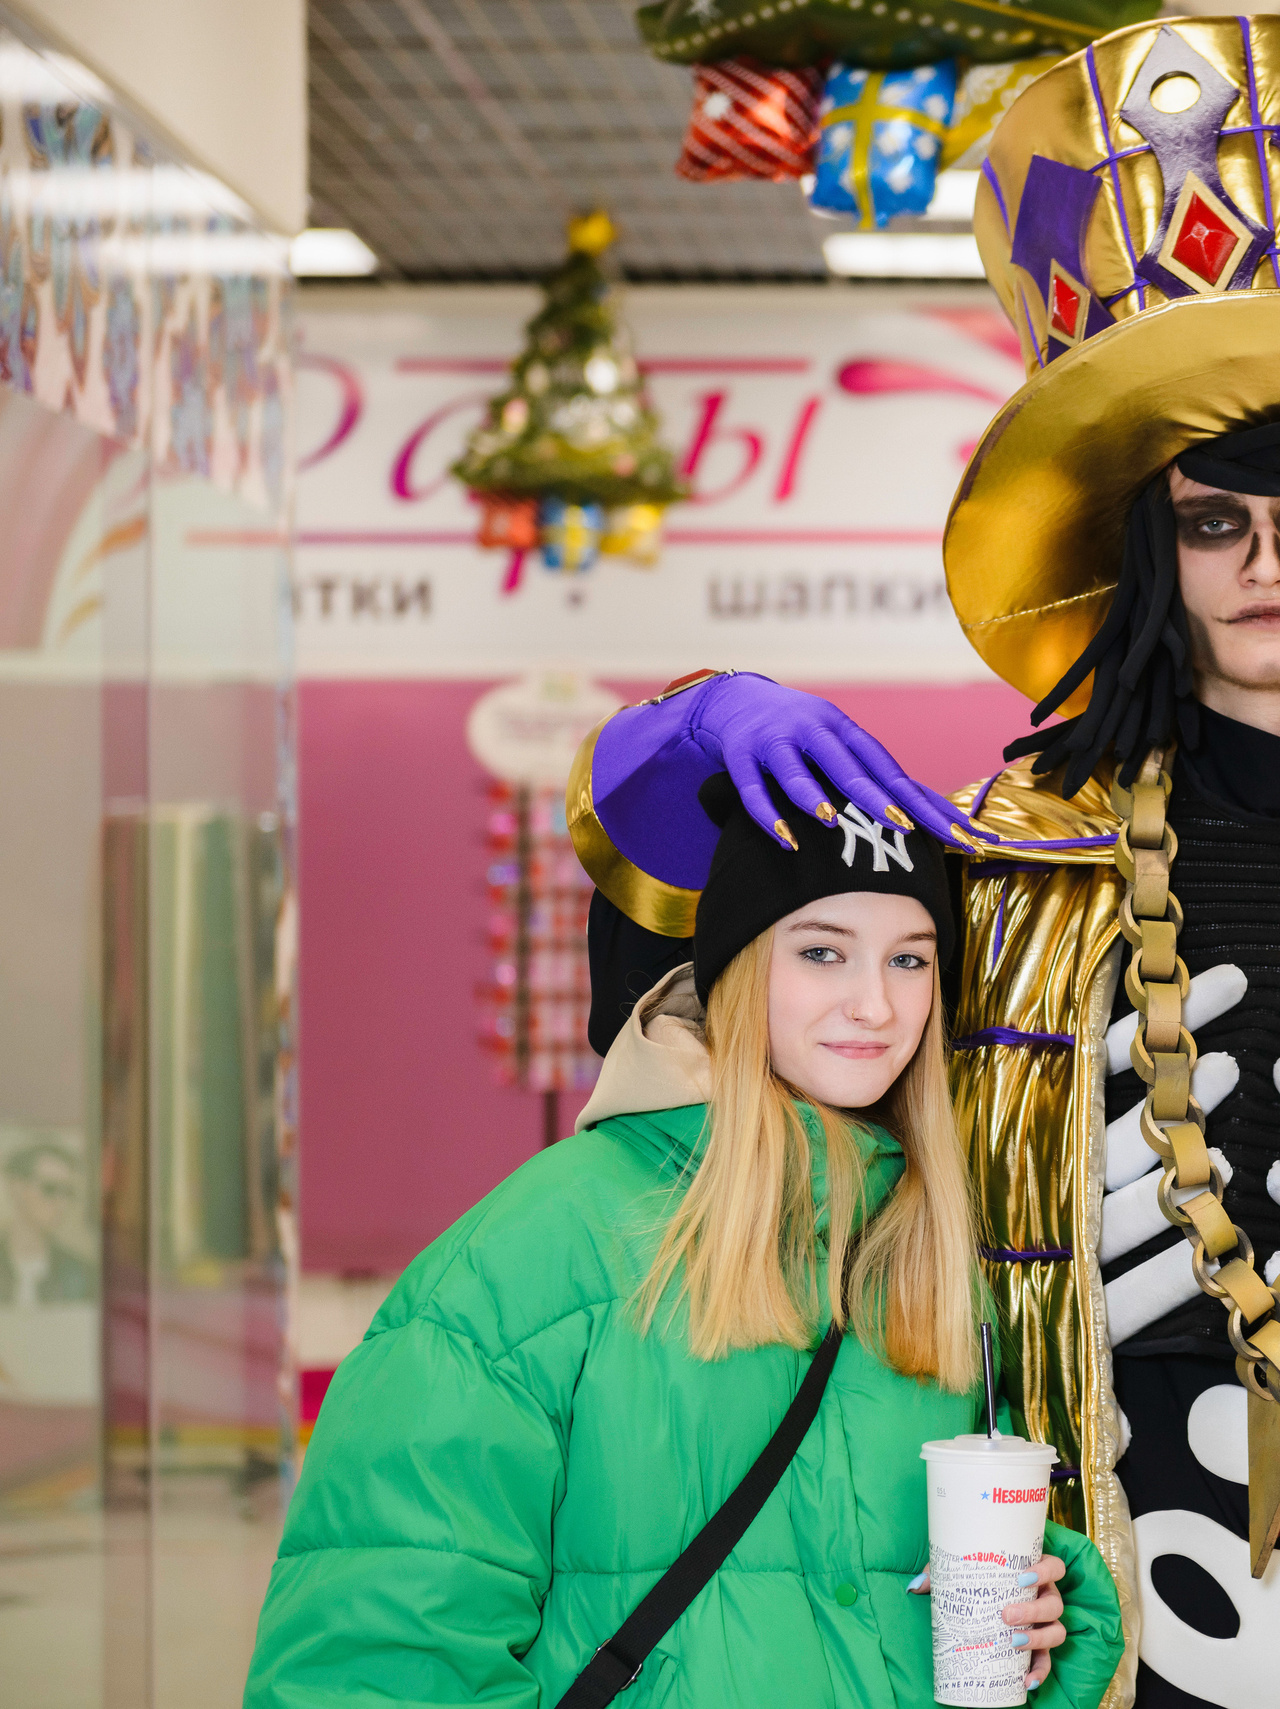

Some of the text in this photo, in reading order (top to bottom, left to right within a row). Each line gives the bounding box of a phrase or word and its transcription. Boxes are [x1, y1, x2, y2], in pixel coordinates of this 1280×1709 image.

[992, 1487, 1047, 1504] HESBURGER
[963, 1552, 1007, 1568] HESBURGER
[955, 1641, 994, 1653] HESBURGER
